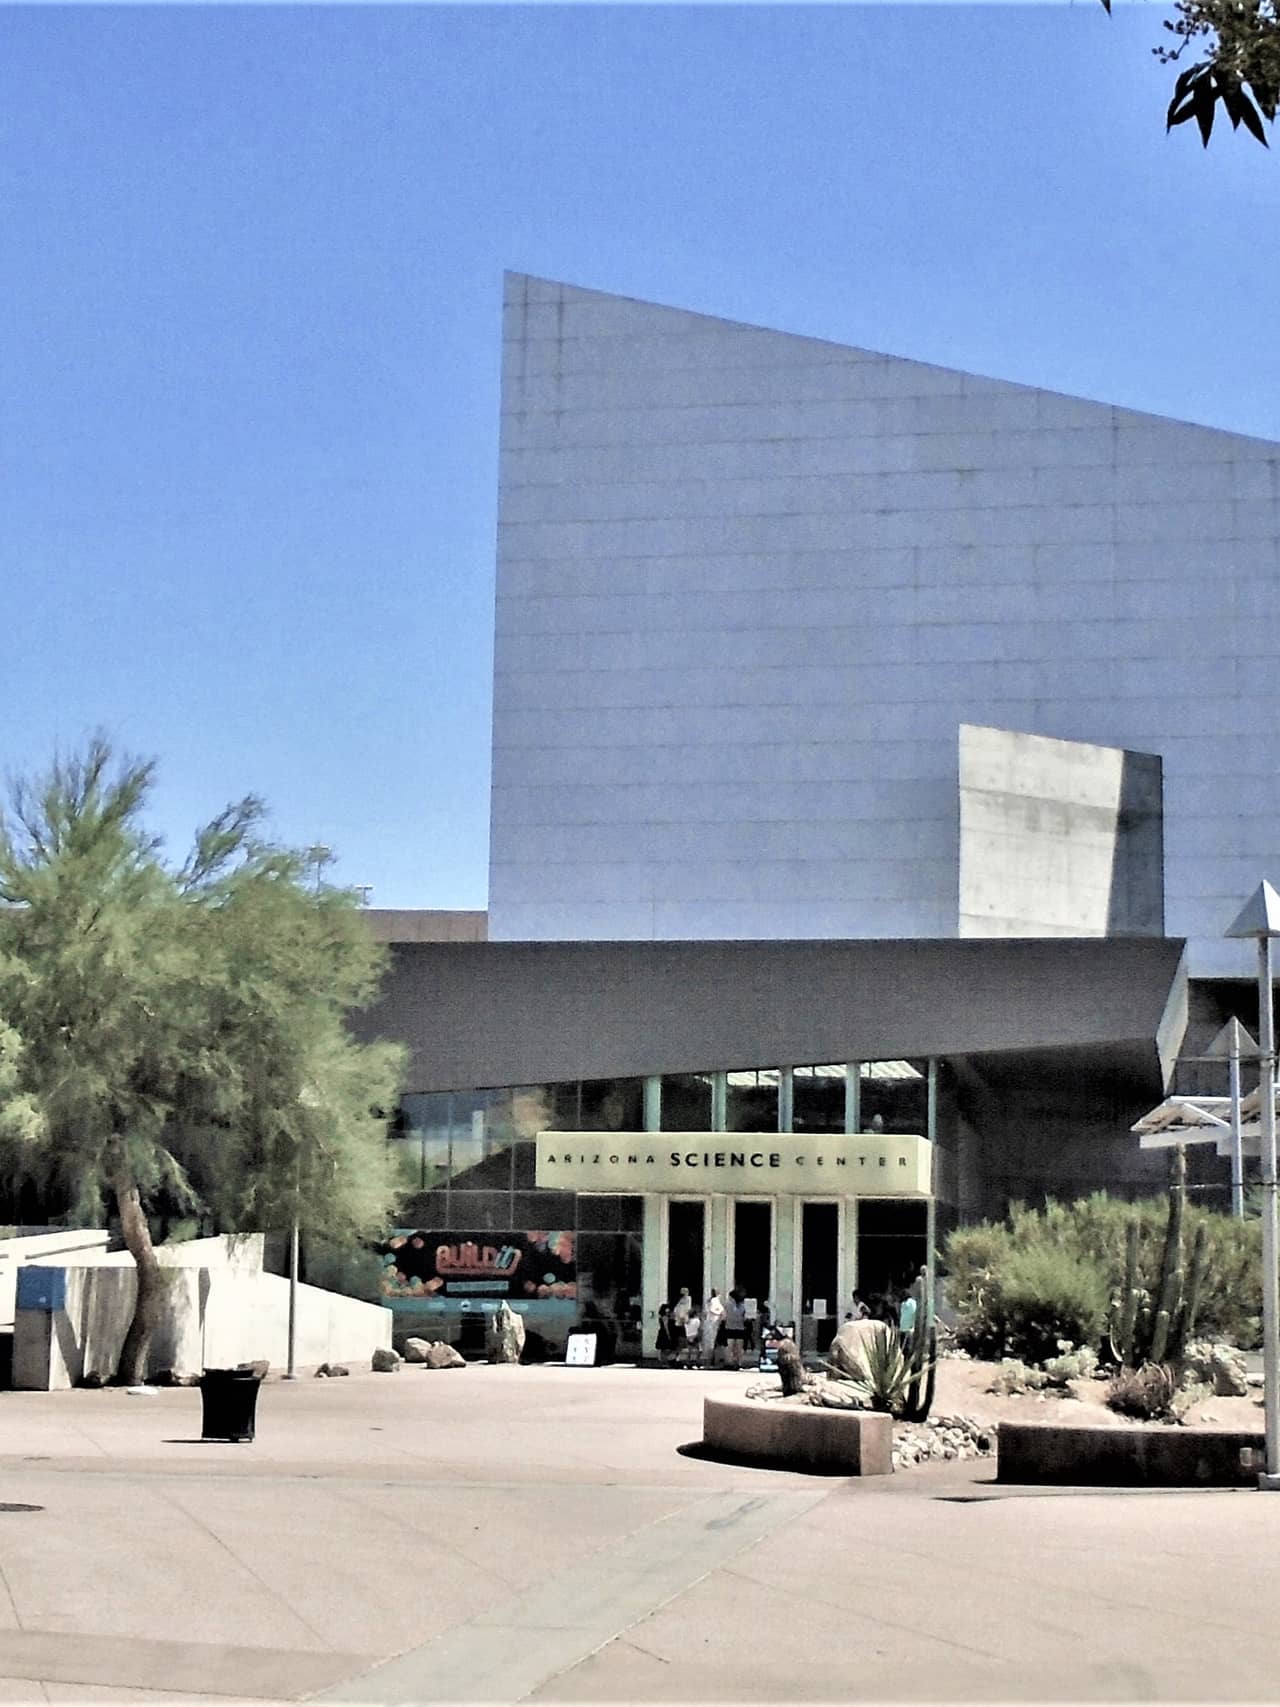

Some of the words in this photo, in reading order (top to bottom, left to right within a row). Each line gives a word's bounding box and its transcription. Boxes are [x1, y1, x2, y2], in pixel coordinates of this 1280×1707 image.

[547, 1153, 656, 1165] ARIZONA
[669, 1151, 781, 1168] SCIENCE
[794, 1155, 908, 1168] CENTER
